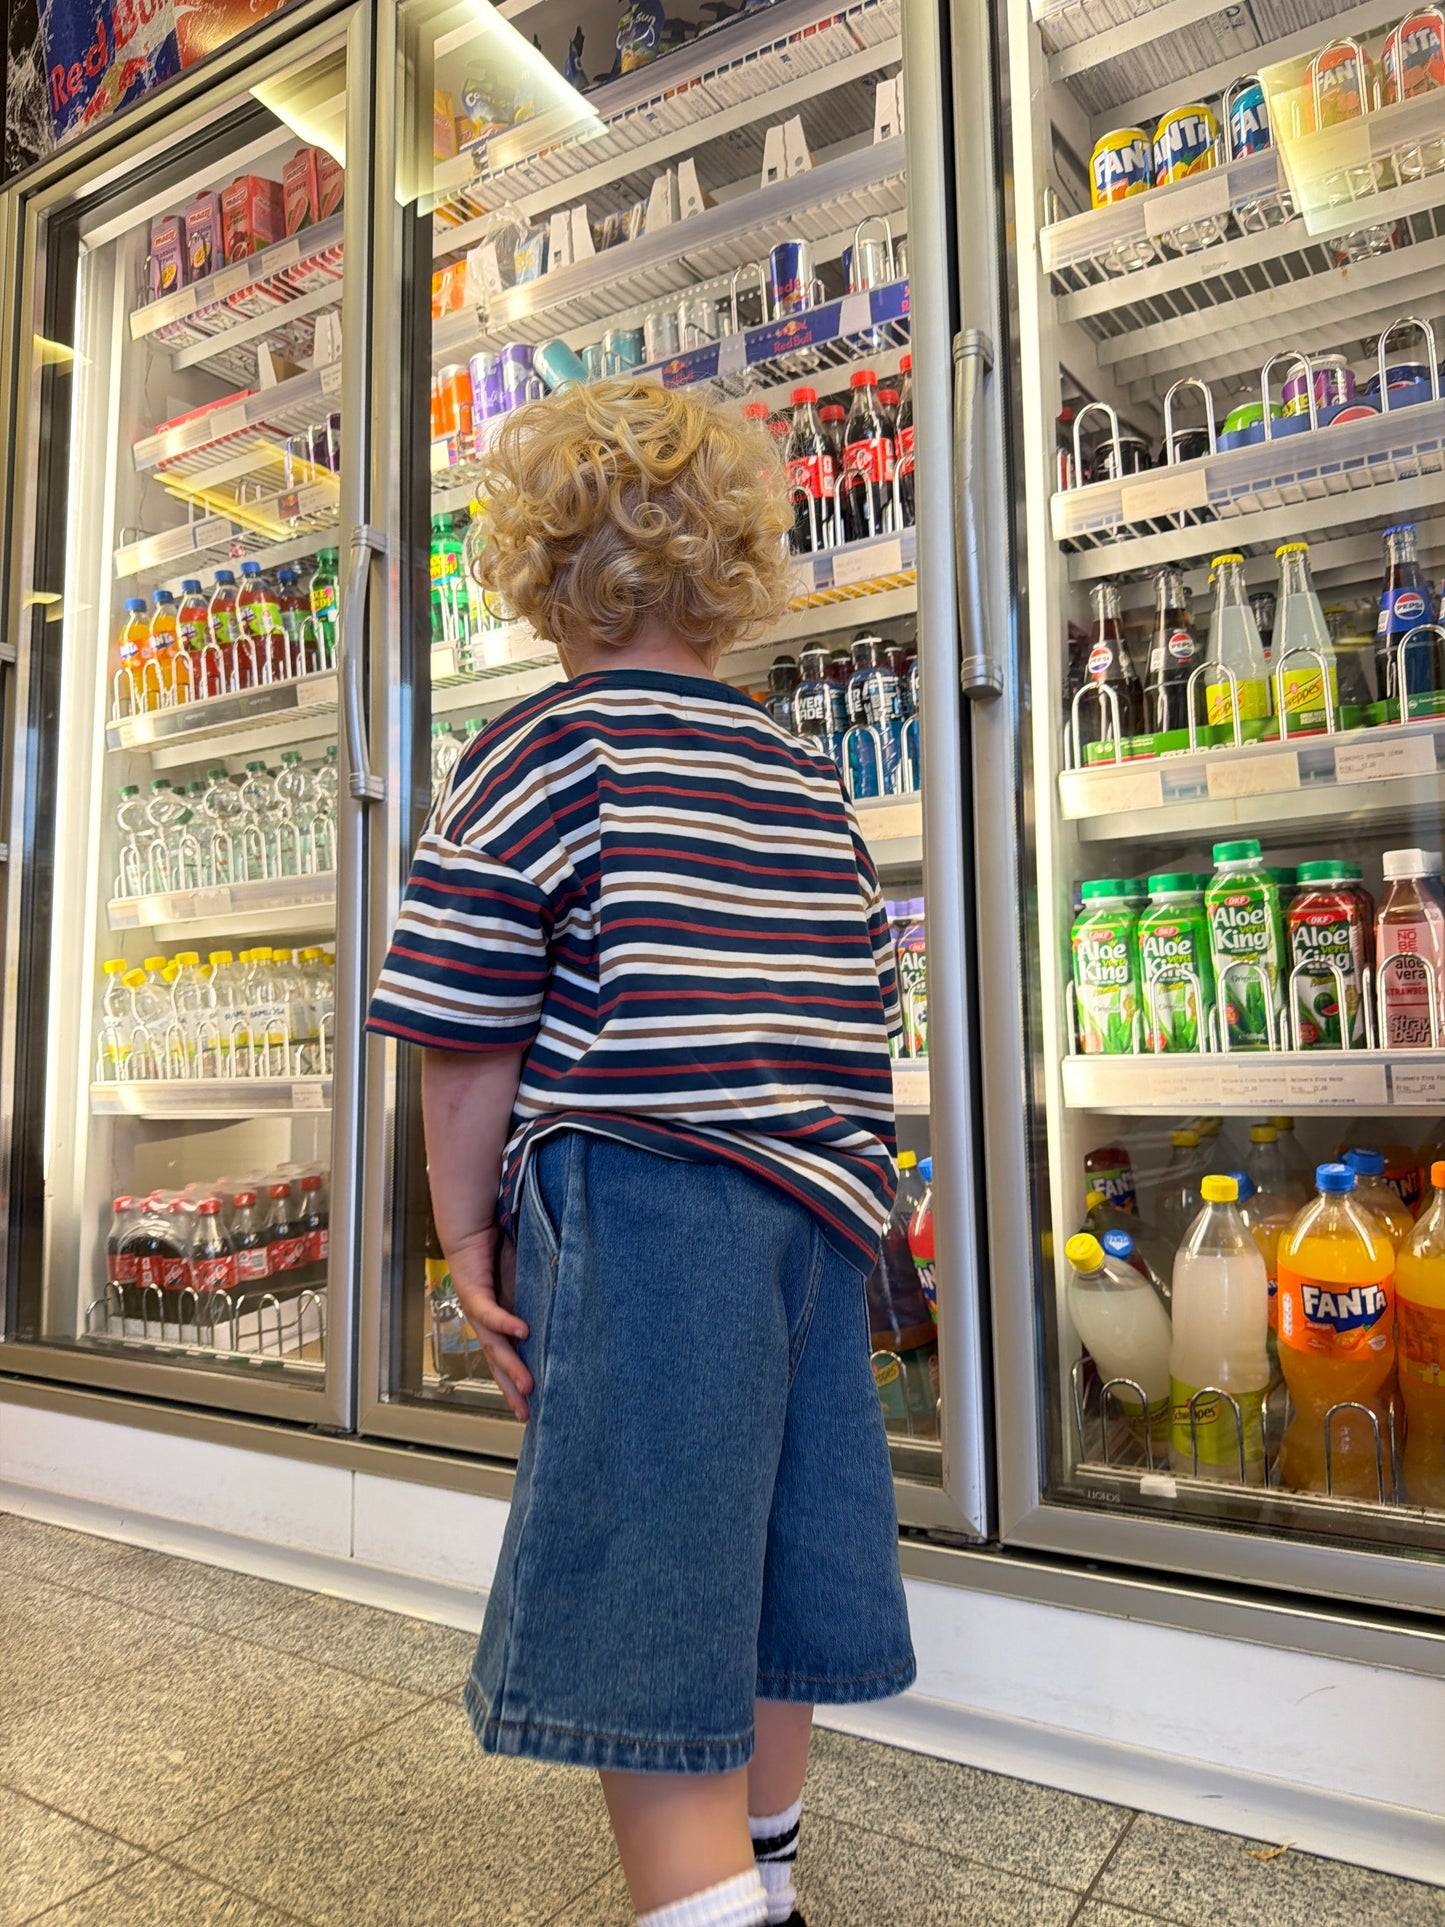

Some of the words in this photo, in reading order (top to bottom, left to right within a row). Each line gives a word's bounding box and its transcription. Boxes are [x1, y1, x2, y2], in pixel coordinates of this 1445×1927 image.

[51, 17, 108, 112] Red
[1154, 115, 1208, 167] ANTA
[1396, 601, 1423, 611] PEPSI
[1214, 907, 1264, 927] Aloe
[1239, 925, 1266, 933] vera
[1294, 926, 1349, 947] Aloe
[1397, 931, 1417, 941] NO
[1143, 936, 1192, 958] Aloe
[1217, 928, 1269, 952] King
[1319, 944, 1348, 954] vera
[1398, 941, 1418, 952] BE
[1077, 940, 1127, 961] Aloe
[1166, 954, 1192, 964] vera
[1296, 949, 1351, 972] King
[900, 952, 926, 971] Alo
[1079, 960, 1129, 983] King
[1101, 958, 1127, 967] vera
[1145, 958, 1194, 980] King
[1395, 956, 1424, 970] aloe
[1395, 970, 1426, 981] vera
[1301, 1284, 1387, 1319] FANTA
